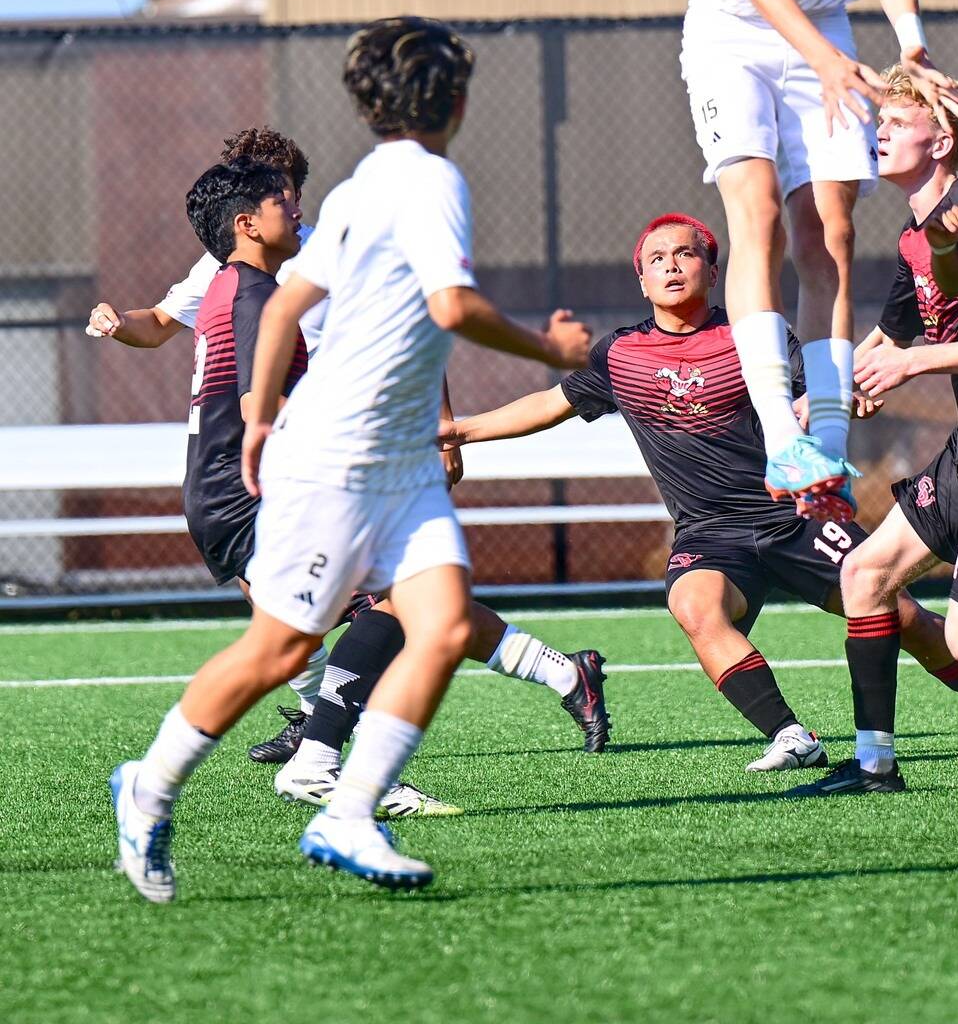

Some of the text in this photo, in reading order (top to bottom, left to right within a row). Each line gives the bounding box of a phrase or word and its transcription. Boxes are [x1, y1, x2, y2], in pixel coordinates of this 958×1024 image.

[701, 97, 718, 124] 15
[672, 379, 690, 390] SVC
[813, 520, 853, 564] 19
[309, 553, 328, 578] 2
